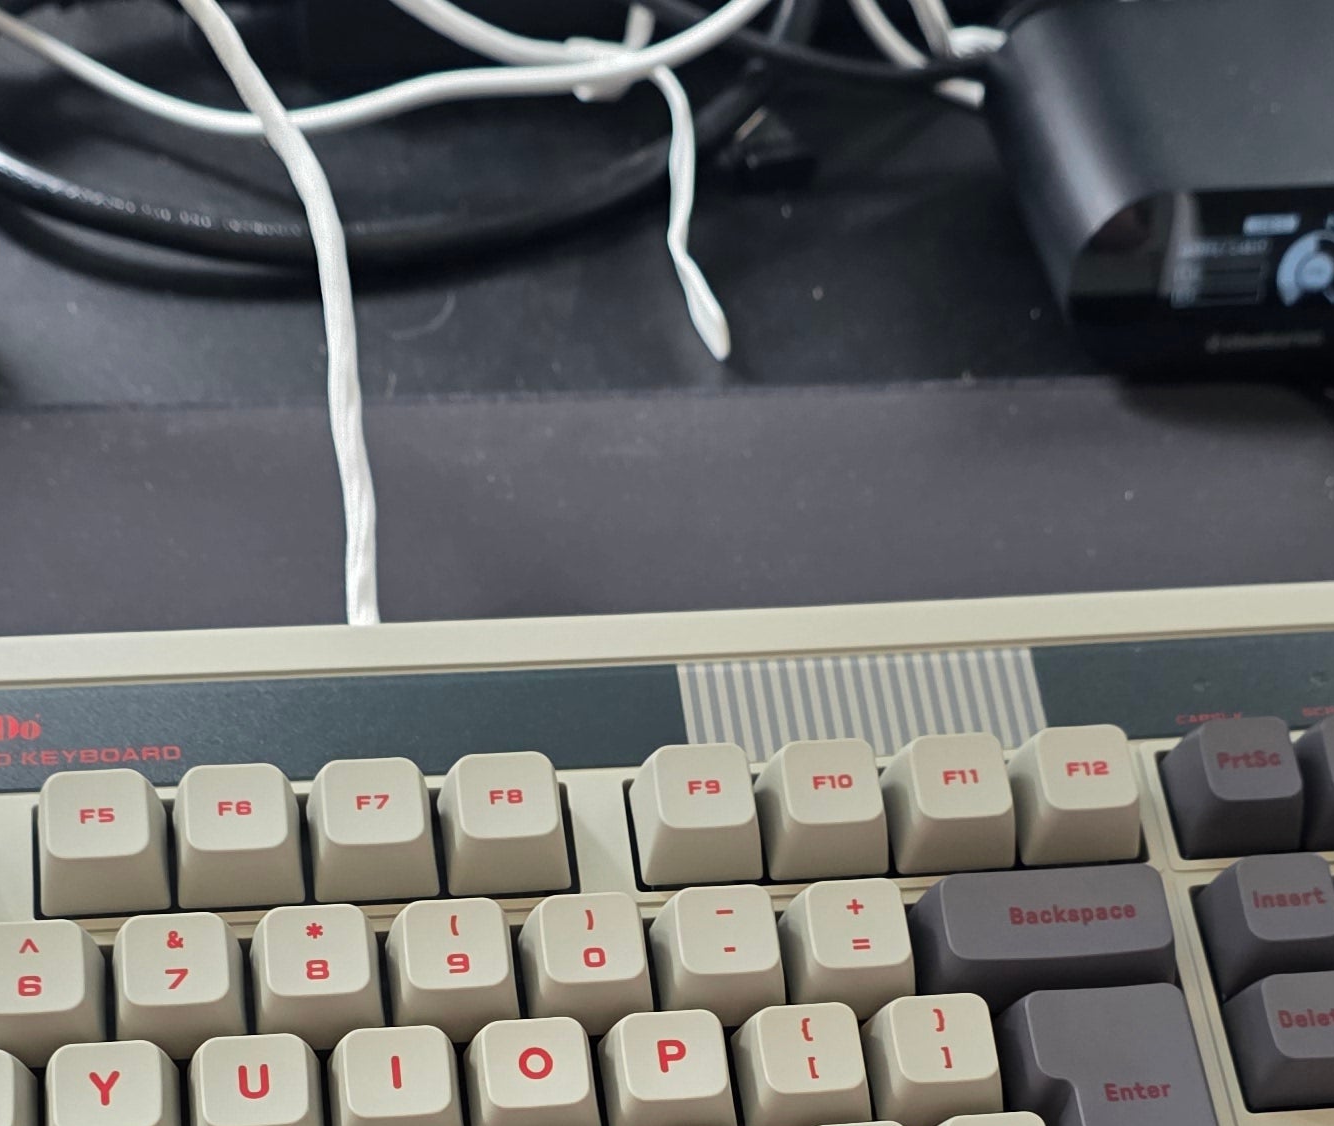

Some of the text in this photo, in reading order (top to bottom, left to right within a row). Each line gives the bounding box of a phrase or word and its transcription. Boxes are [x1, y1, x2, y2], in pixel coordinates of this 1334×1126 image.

[20, 745, 181, 765] KEYBOARD
[1217, 750, 1280, 769] PrtSc
[941, 768, 979, 785] F11
[1065, 760, 1109, 777] F12
[686, 779, 722, 795] F9
[811, 773, 854, 790] F10
[355, 793, 390, 810] F7
[488, 788, 524, 805] F8
[78, 806, 115, 824] F5
[216, 799, 253, 816] F6
[847, 898, 864, 915] +
[1252, 887, 1325, 908] Insert
[449, 914, 460, 937] (
[584, 908, 596, 932] )
[1008, 905, 1137, 925] Backspace
[166, 930, 184, 949] &
[851, 937, 872, 952] =
[446, 952, 471, 975] 9
[582, 946, 607, 969] 0
[165, 967, 189, 990] 7
[305, 959, 330, 981] 8
[16, 975, 42, 997] 6
[800, 1017, 814, 1043] {
[932, 1007, 946, 1034] }
[518, 1046, 554, 1080] O
[656, 1039, 687, 1073] P
[940, 1045, 954, 1070] ]
[390, 1055, 403, 1089] I
[806, 1055, 820, 1080] [
[88, 1070, 120, 1106] Y
[237, 1063, 270, 1100] U
[1104, 1082, 1171, 1103] Enter
